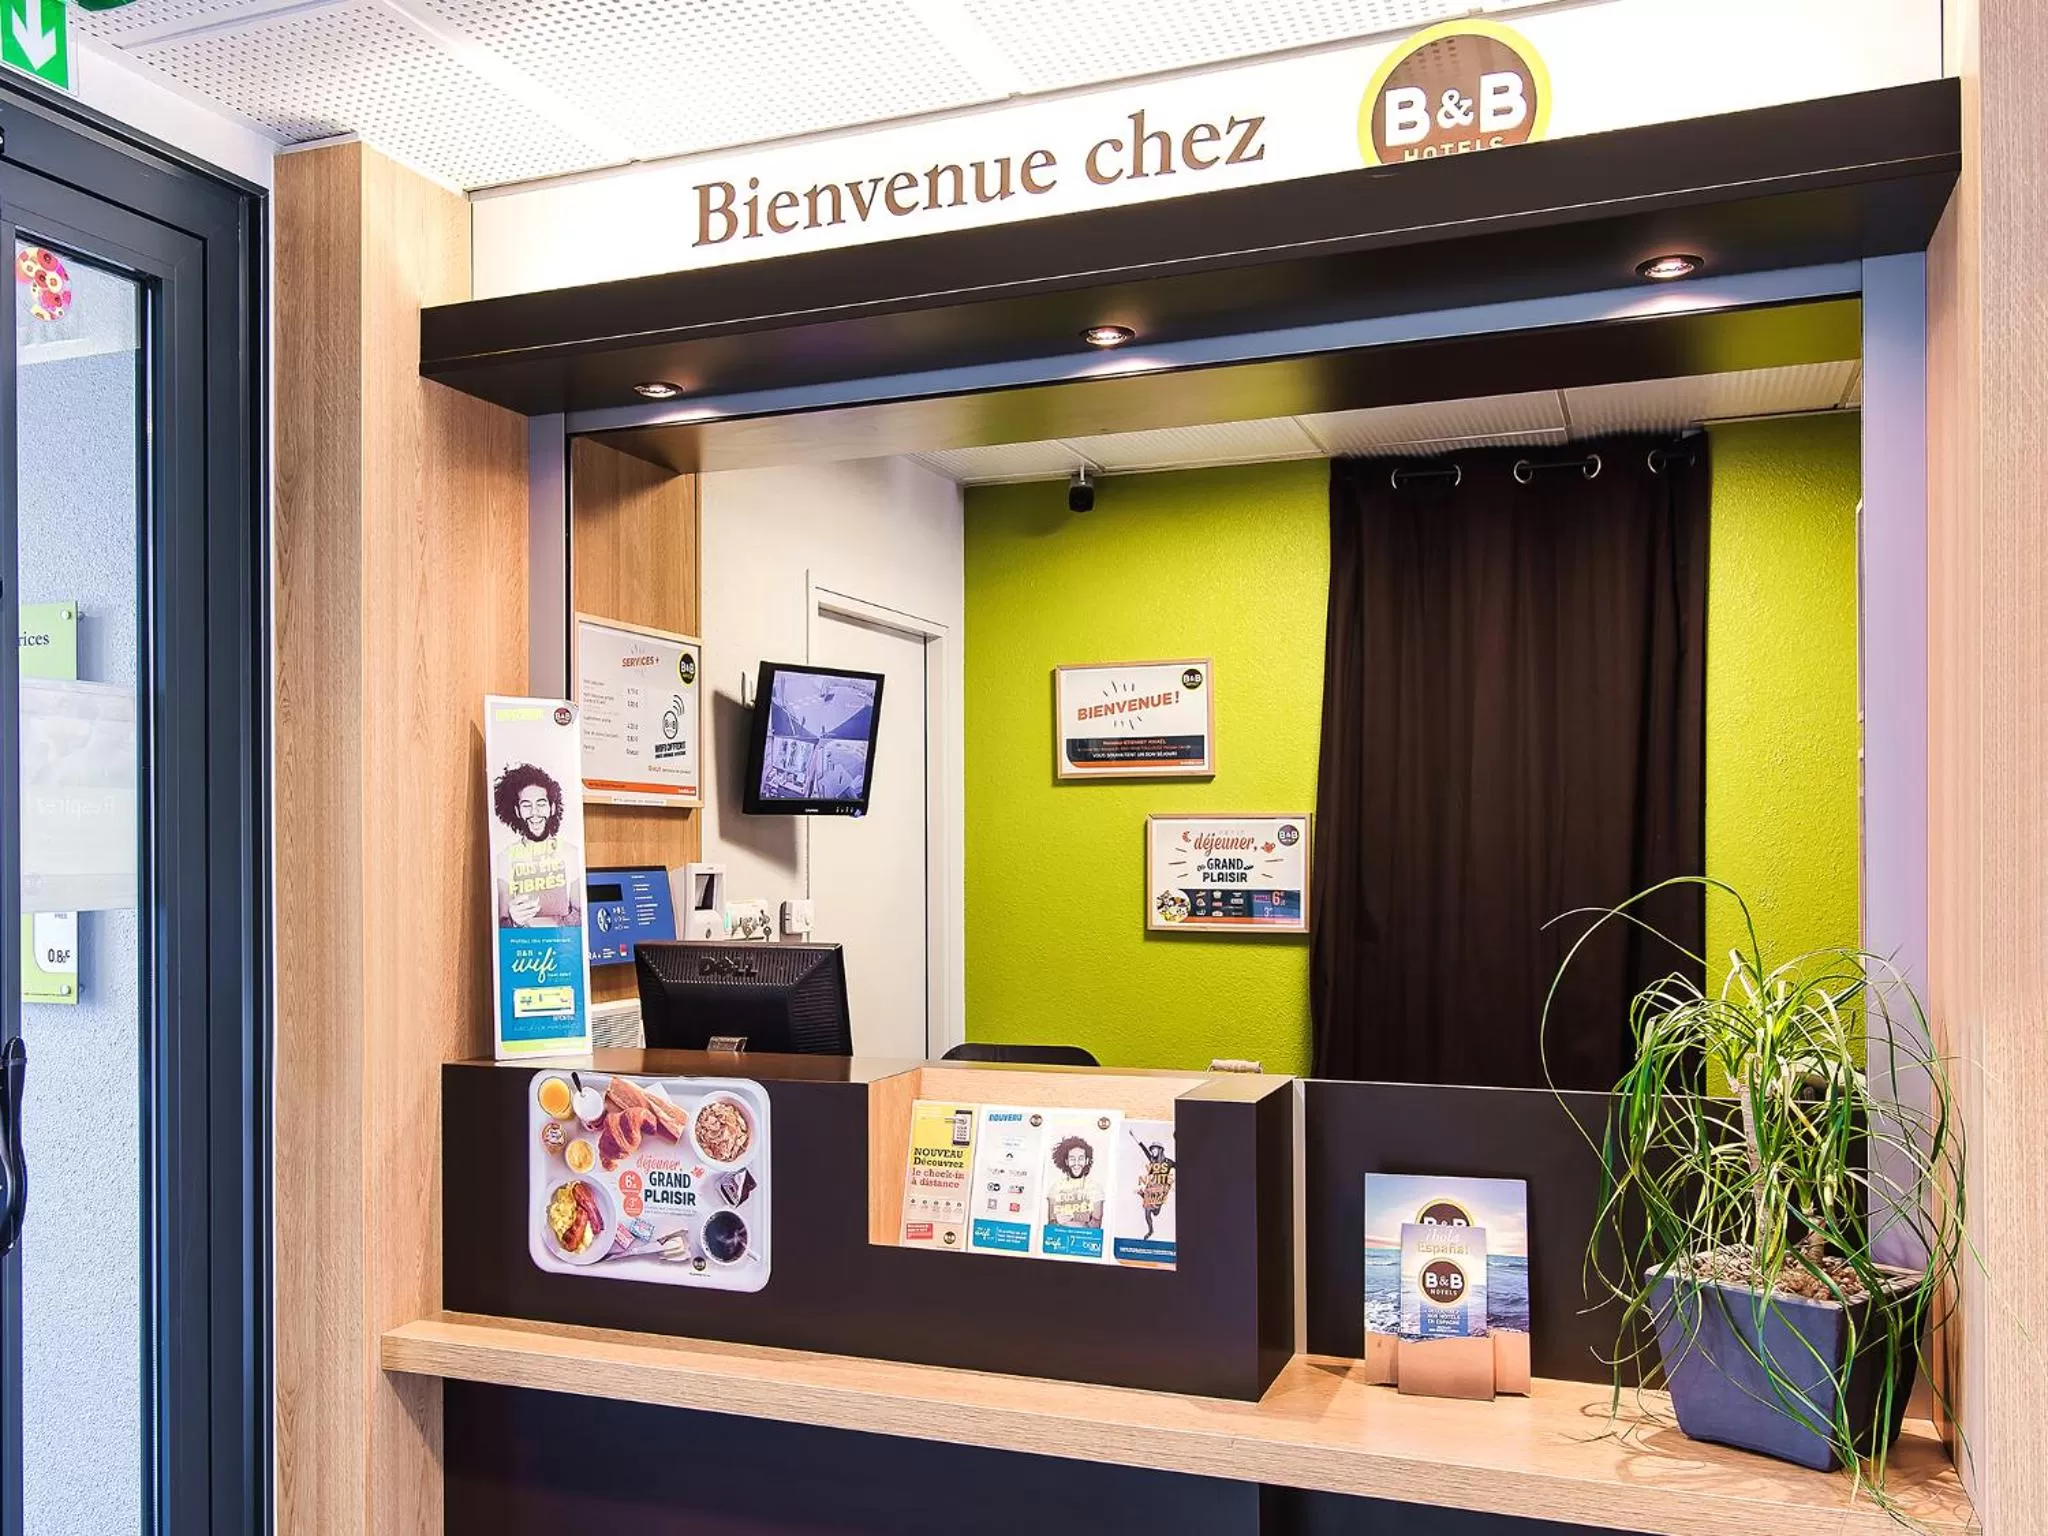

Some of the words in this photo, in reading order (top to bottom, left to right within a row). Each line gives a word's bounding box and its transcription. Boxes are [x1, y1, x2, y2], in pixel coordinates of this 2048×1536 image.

[1385, 71, 1528, 147] B&B
[691, 149, 1058, 248] Bienvenue
[1085, 109, 1267, 186] chez
[18, 631, 50, 647] rices
[622, 657, 654, 667] SERVICES
[1206, 858, 1243, 870] GRAND
[1202, 872, 1248, 883] PLAISIR
[511, 946, 557, 983] wifi
[700, 956, 758, 976] DELL
[913, 1148, 964, 1158] NOUVEAU
[913, 1157, 964, 1169] Découvrez
[649, 1171, 691, 1189] GRAND
[912, 1167, 921, 1176] le
[923, 1168, 965, 1180] check-in
[911, 1176, 917, 1185] à
[919, 1177, 960, 1189] distance
[644, 1189, 696, 1207] PLAISIR
[1425, 1271, 1463, 1289] B&B
